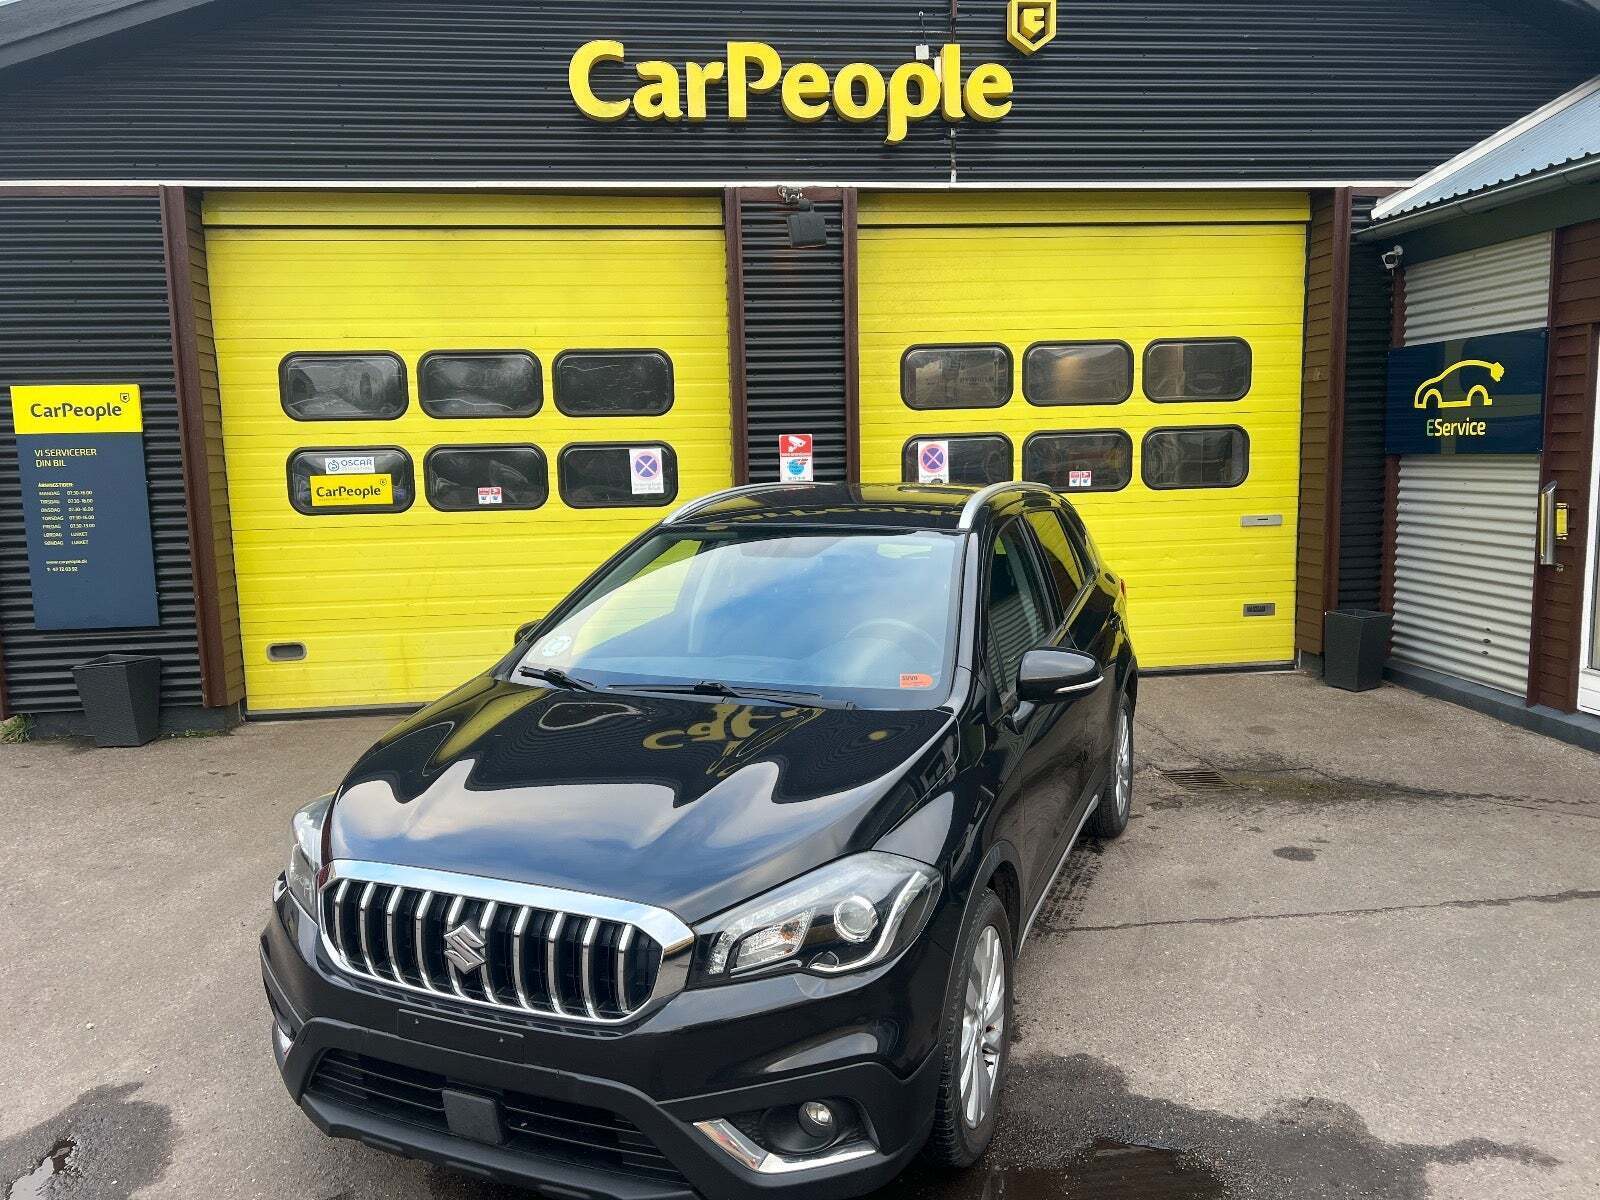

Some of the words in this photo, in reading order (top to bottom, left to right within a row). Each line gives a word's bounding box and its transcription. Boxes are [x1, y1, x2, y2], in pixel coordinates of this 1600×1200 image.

[567, 38, 1014, 144] CarPeople
[30, 402, 122, 421] CarPeople
[1426, 417, 1486, 437] EService
[34, 449, 43, 457] VI
[45, 448, 97, 457] SERVICERER
[35, 459, 51, 468] DIN
[53, 459, 67, 467] BIL
[341, 459, 373, 467] OSCAR
[316, 485, 381, 499] CarPeople
